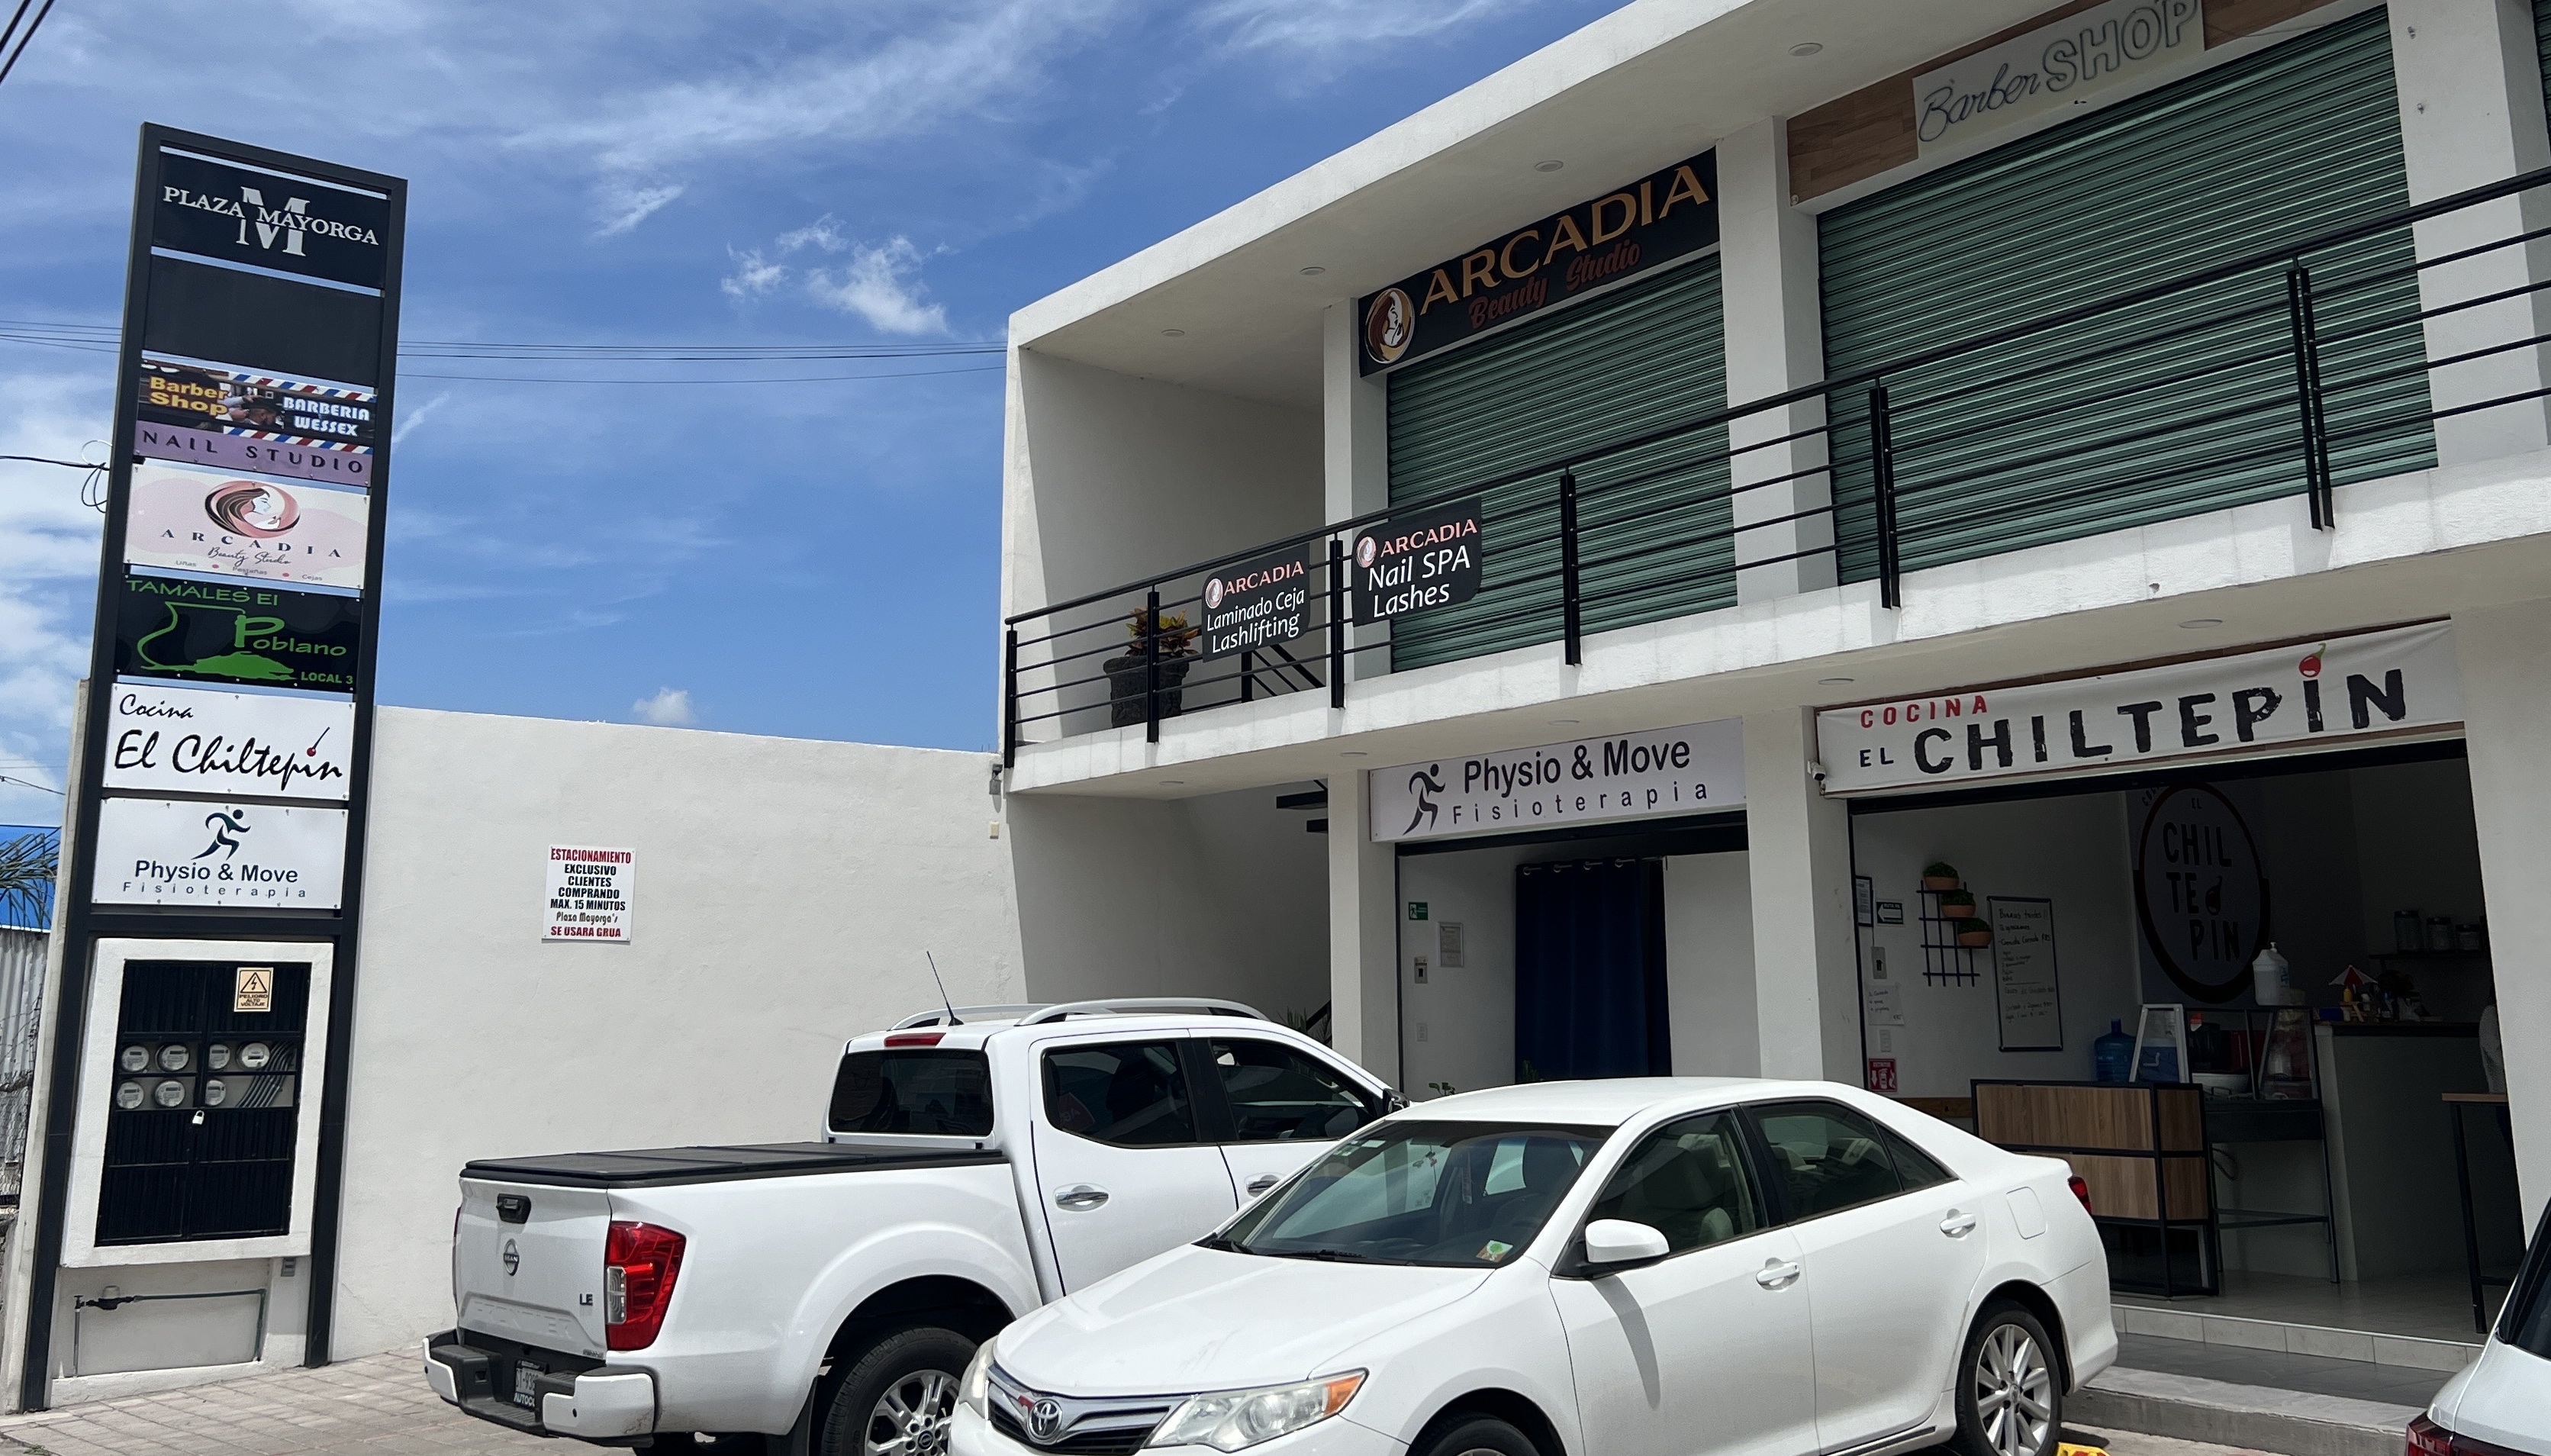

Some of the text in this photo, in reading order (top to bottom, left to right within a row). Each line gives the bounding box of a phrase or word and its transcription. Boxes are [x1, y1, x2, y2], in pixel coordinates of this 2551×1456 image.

[1918, 0, 2198, 143] Barber SHOP
[163, 185, 379, 246] PLAZA MAYORGA
[1419, 164, 1710, 316] ARCADIA
[1467, 238, 1642, 330] Beauty Studio
[150, 376, 229, 401] Barber
[150, 391, 230, 417] Shop
[282, 396, 370, 422] BARBERIA
[294, 414, 359, 437] WESSEX
[142, 430, 363, 474] NAIL STUDIO
[161, 529, 341, 558] ARCADIA
[1380, 518, 1477, 558] ARCADIA
[208, 546, 291, 567] Beauty Studio
[1367, 544, 1470, 591] Nail SPA
[126, 580, 250, 603] TAMALES
[1223, 561, 1304, 597] ARCADIA
[1206, 587, 1305, 632] Laminado Ceja
[1373, 582, 1450, 618] Lashes
[234, 614, 346, 656] Poblano
[1212, 612, 1300, 654] Lashlifting
[301, 671, 353, 685] LOCAL 3
[119, 693, 193, 719] Cocina
[1860, 694, 1988, 730] COCINA
[114, 729, 159, 768] El
[1859, 746, 1894, 768] EL
[1464, 738, 1691, 799] Physio & Move
[1452, 780, 1708, 825] Fisioterapia
[2192, 797, 2202, 810] EL
[550, 848, 631, 864] ESTACIONAMIENTO
[2163, 821, 2232, 867] CHIL
[135, 859, 298, 883] Physio & Move
[564, 863, 617, 876] EXCLUSIVO
[568, 875, 612, 887] CLIENTES
[123, 881, 306, 899] Fisioterapia
[558, 887, 620, 899] COMPRANDO
[2166, 871, 2199, 914] TE
[550, 898, 626, 910] MAX. 15 MINUTOS
[556, 911, 577, 922] Plaza
[551, 926, 621, 938] SE USARA GRUA
[2189, 919, 2240, 962] PIN
[579, 1293, 593, 1306] LE
